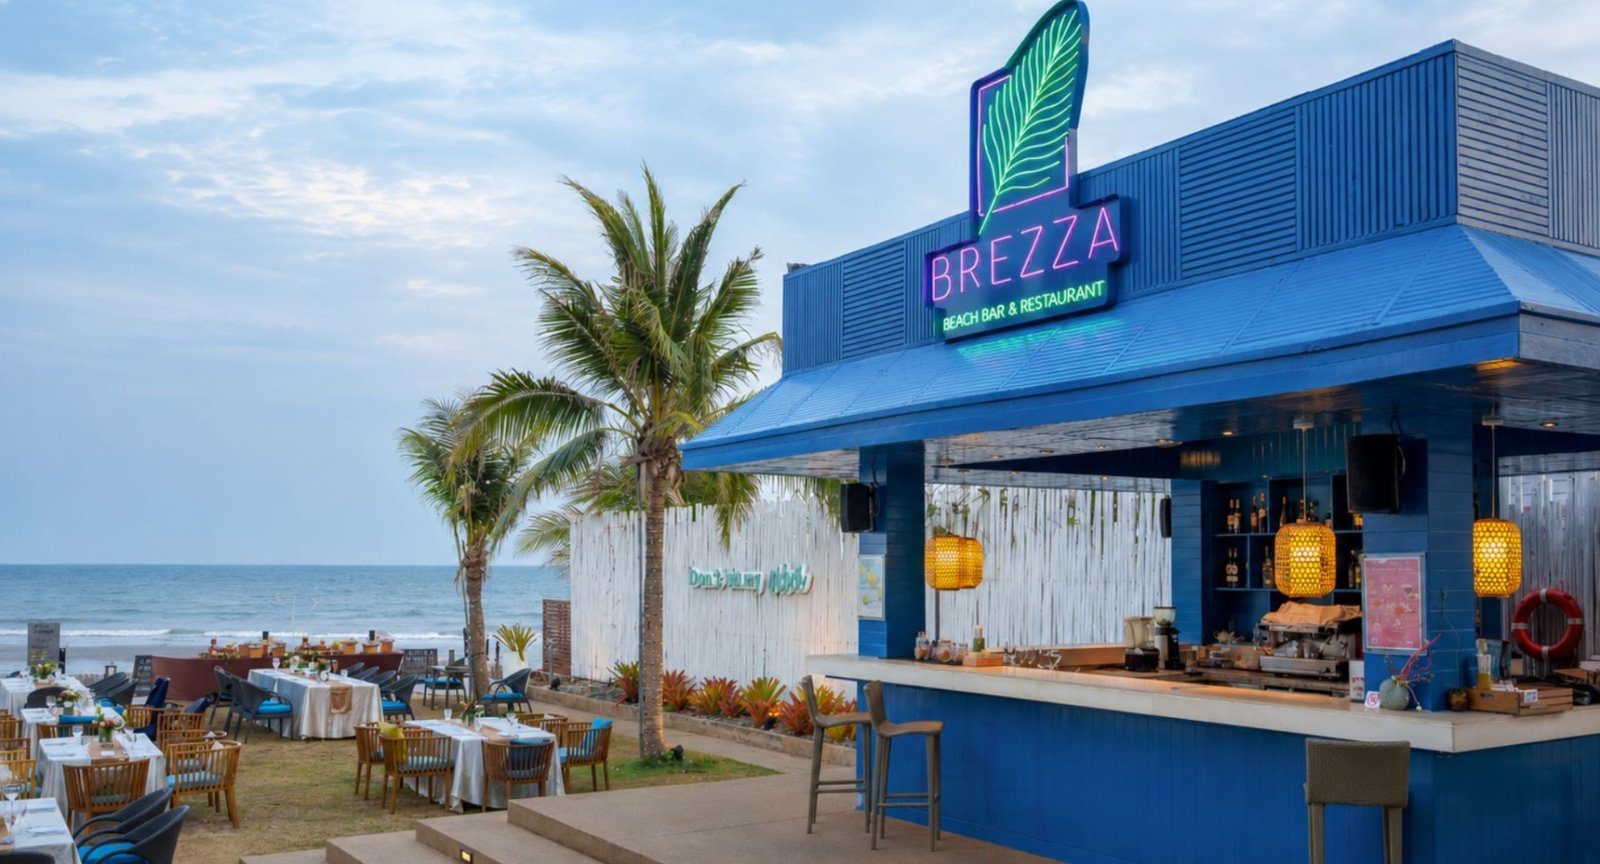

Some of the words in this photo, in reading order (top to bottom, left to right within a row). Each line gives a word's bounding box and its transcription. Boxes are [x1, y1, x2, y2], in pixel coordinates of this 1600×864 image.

[932, 207, 1119, 302] BREZZA
[943, 311, 979, 332] BEACH
[982, 304, 1005, 322] BAR
[1008, 302, 1018, 316] &
[1020, 280, 1105, 314] RESTAURANT
